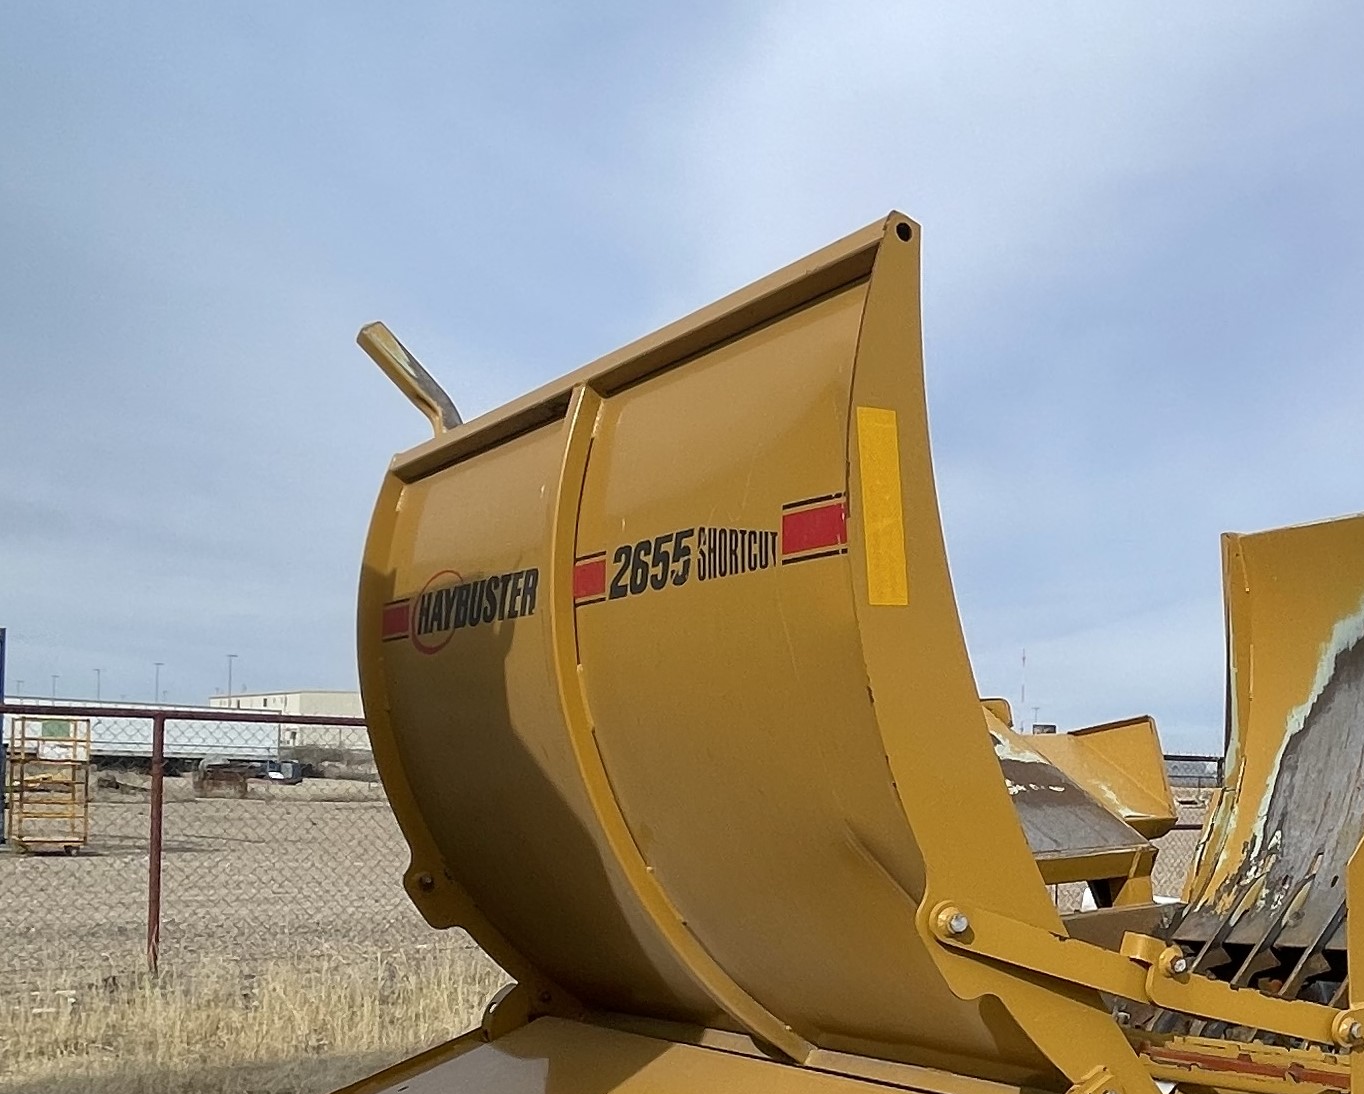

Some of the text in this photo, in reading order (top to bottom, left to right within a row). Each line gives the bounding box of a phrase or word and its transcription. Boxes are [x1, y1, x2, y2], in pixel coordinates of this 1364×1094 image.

[608, 526, 778, 600] 2655 SHORTCUT
[417, 567, 539, 635] HAYBUSTER
